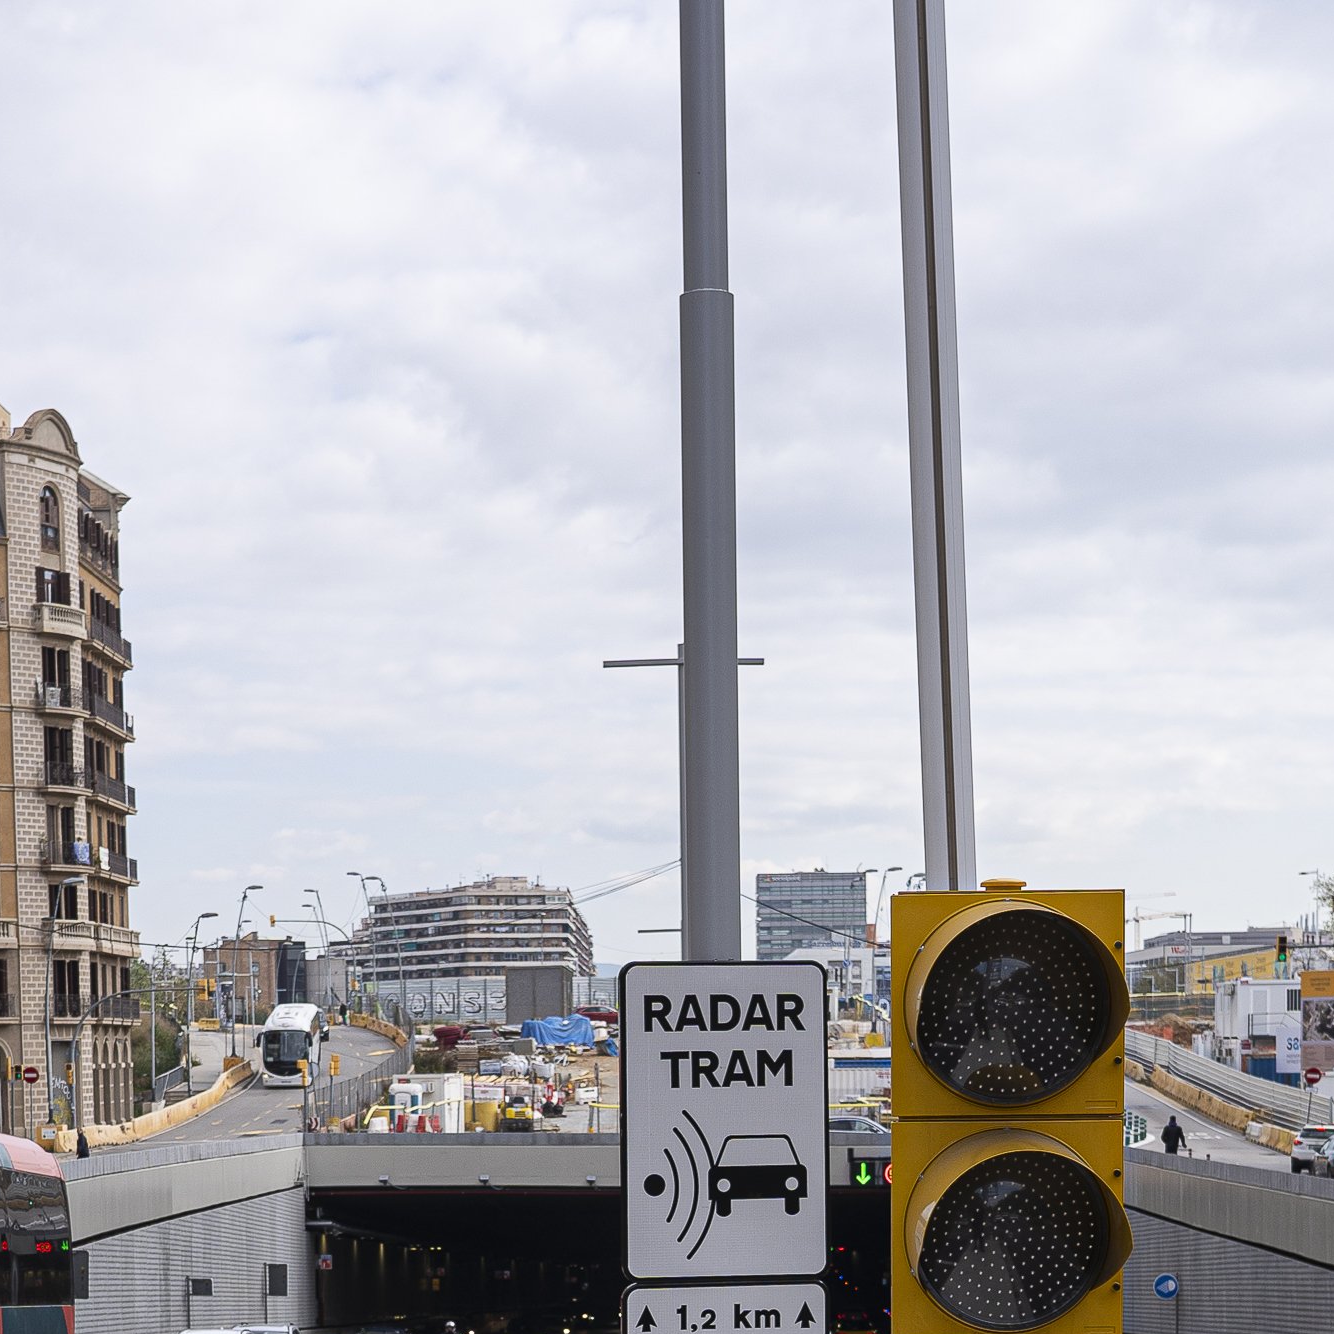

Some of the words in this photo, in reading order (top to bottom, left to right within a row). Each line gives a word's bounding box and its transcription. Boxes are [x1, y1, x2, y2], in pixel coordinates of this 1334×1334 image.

[643, 993, 806, 1033] RADAR
[659, 1049, 794, 1089] TRAM
[676, 1304, 717, 1333] 1,2
[733, 1303, 782, 1330] km
